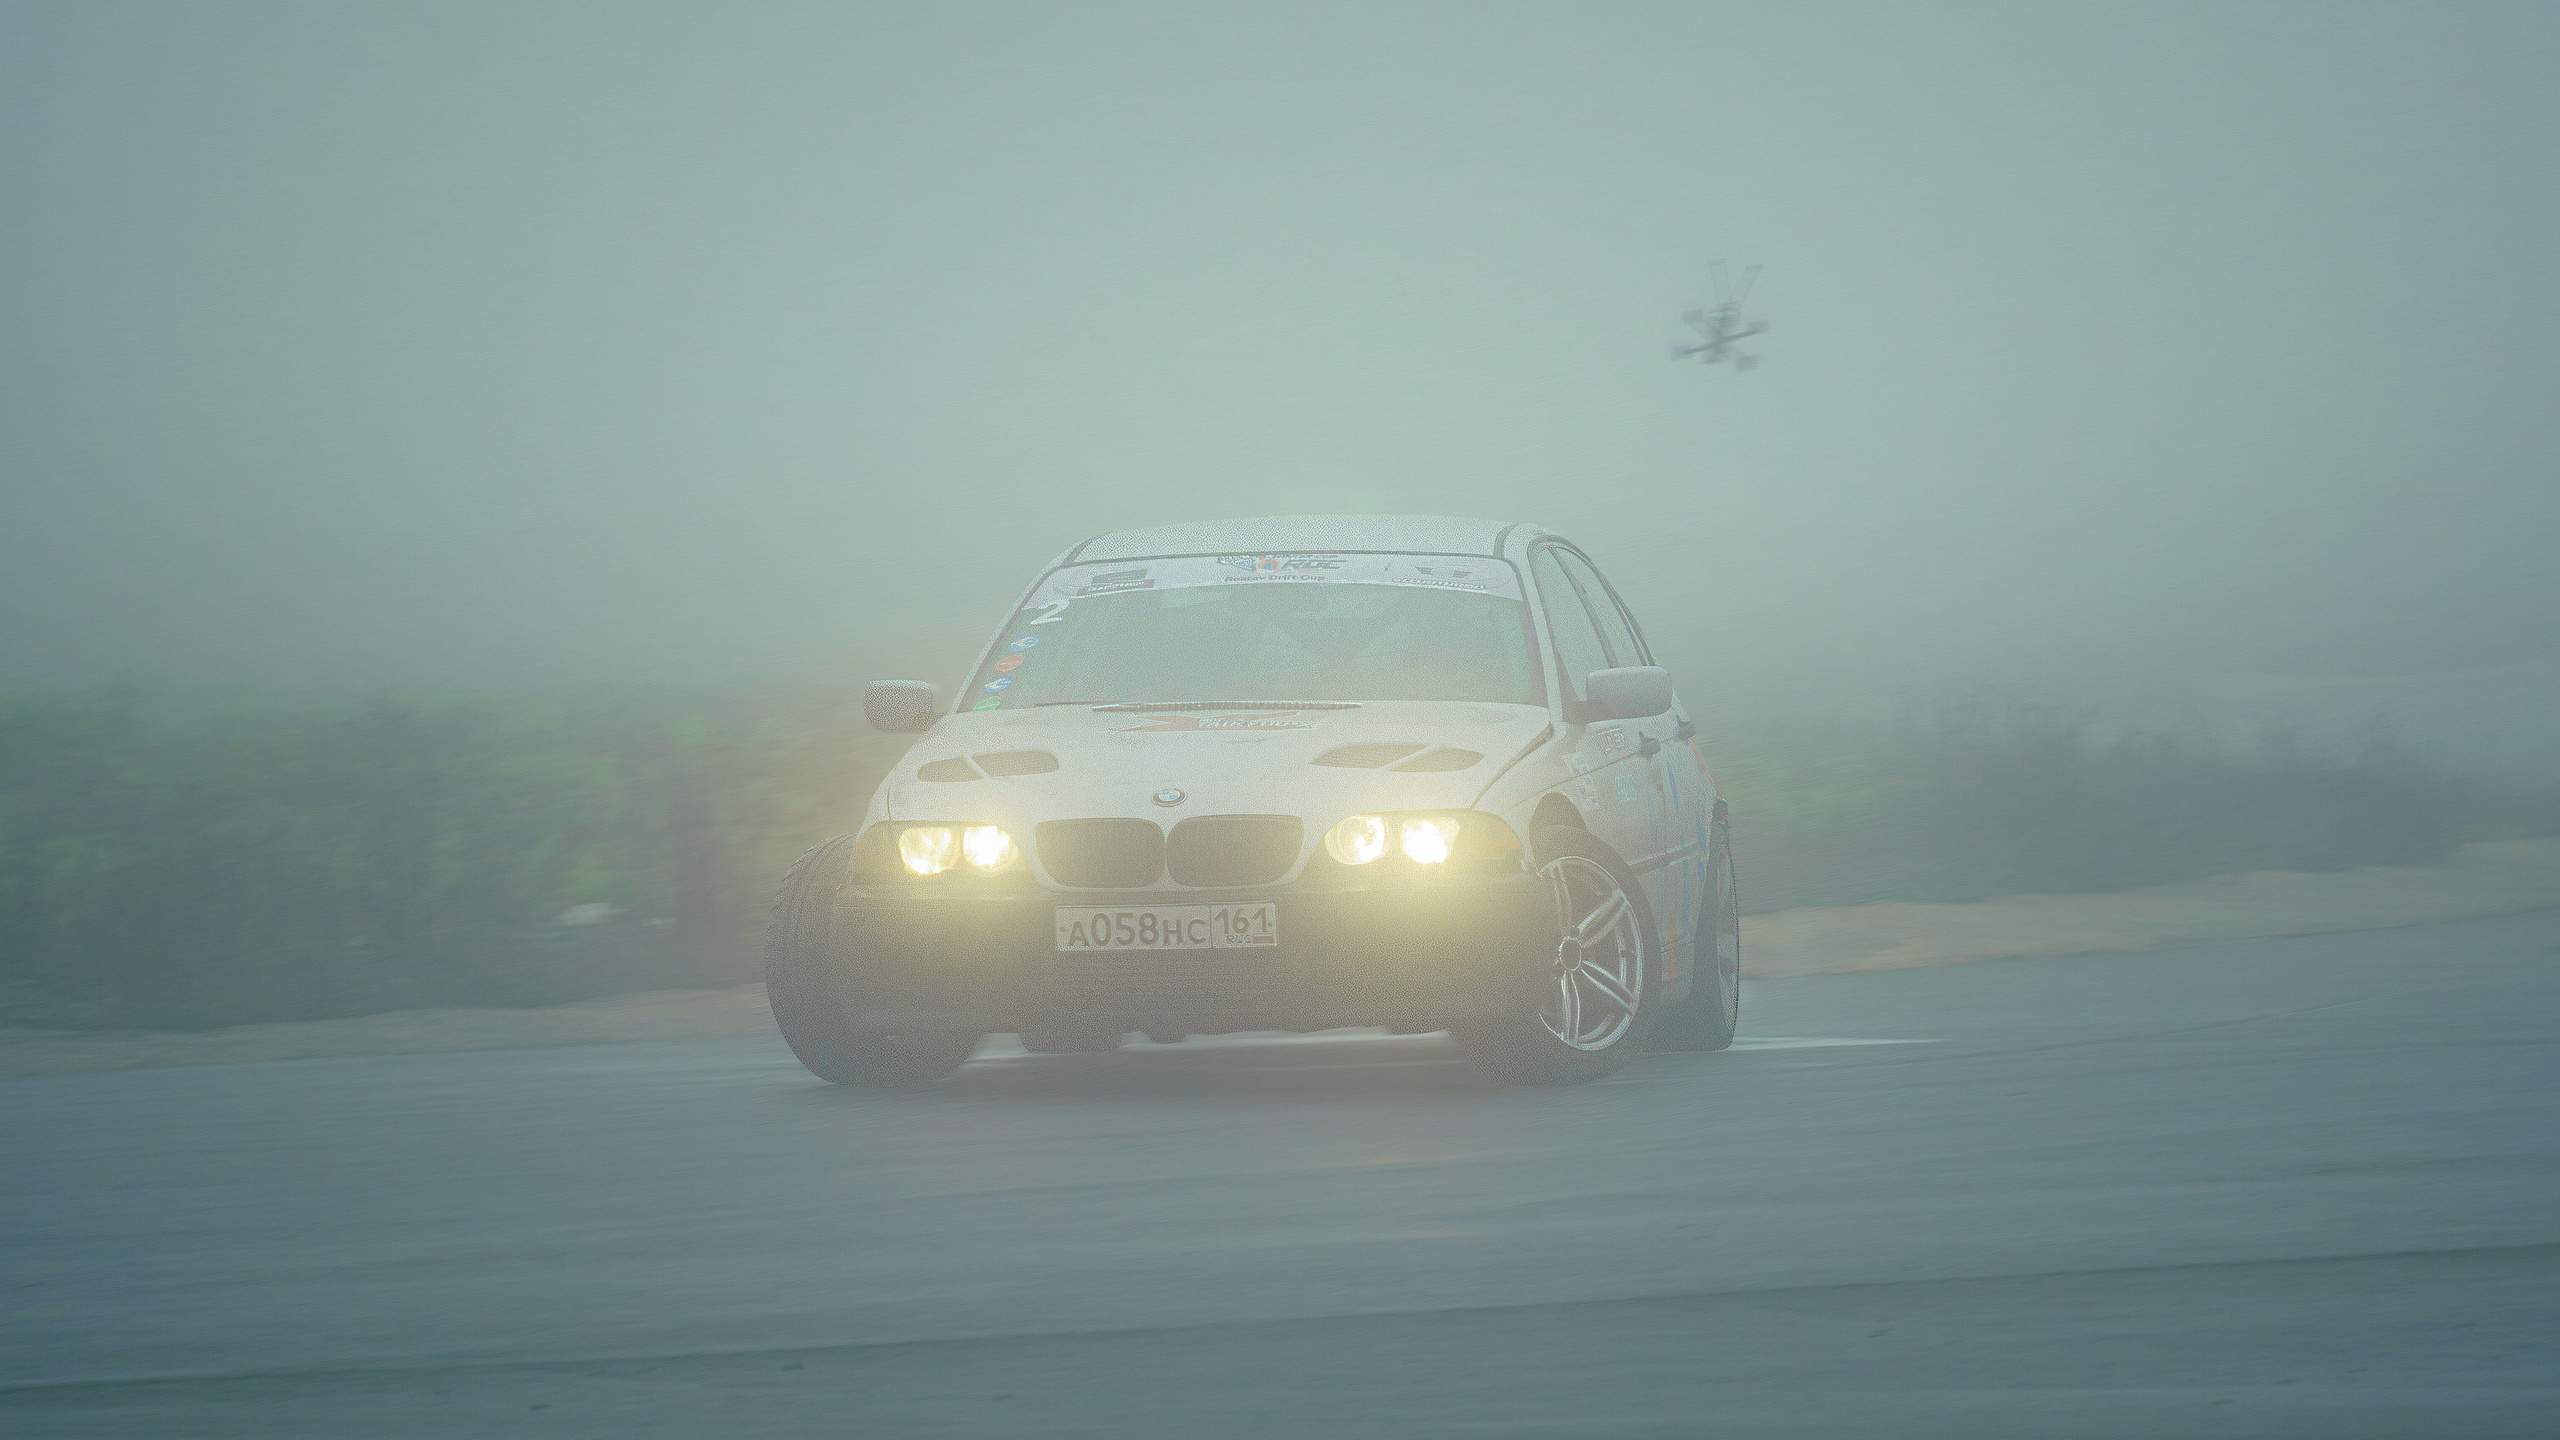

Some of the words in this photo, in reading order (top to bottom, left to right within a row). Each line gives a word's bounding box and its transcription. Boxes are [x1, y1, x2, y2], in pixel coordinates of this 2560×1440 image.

[1281, 559, 1347, 569] RDC
[1300, 574, 1325, 582] Cup
[1030, 599, 1070, 625] 2
[1068, 912, 1207, 946] А058НС
[1214, 907, 1269, 934] 161
